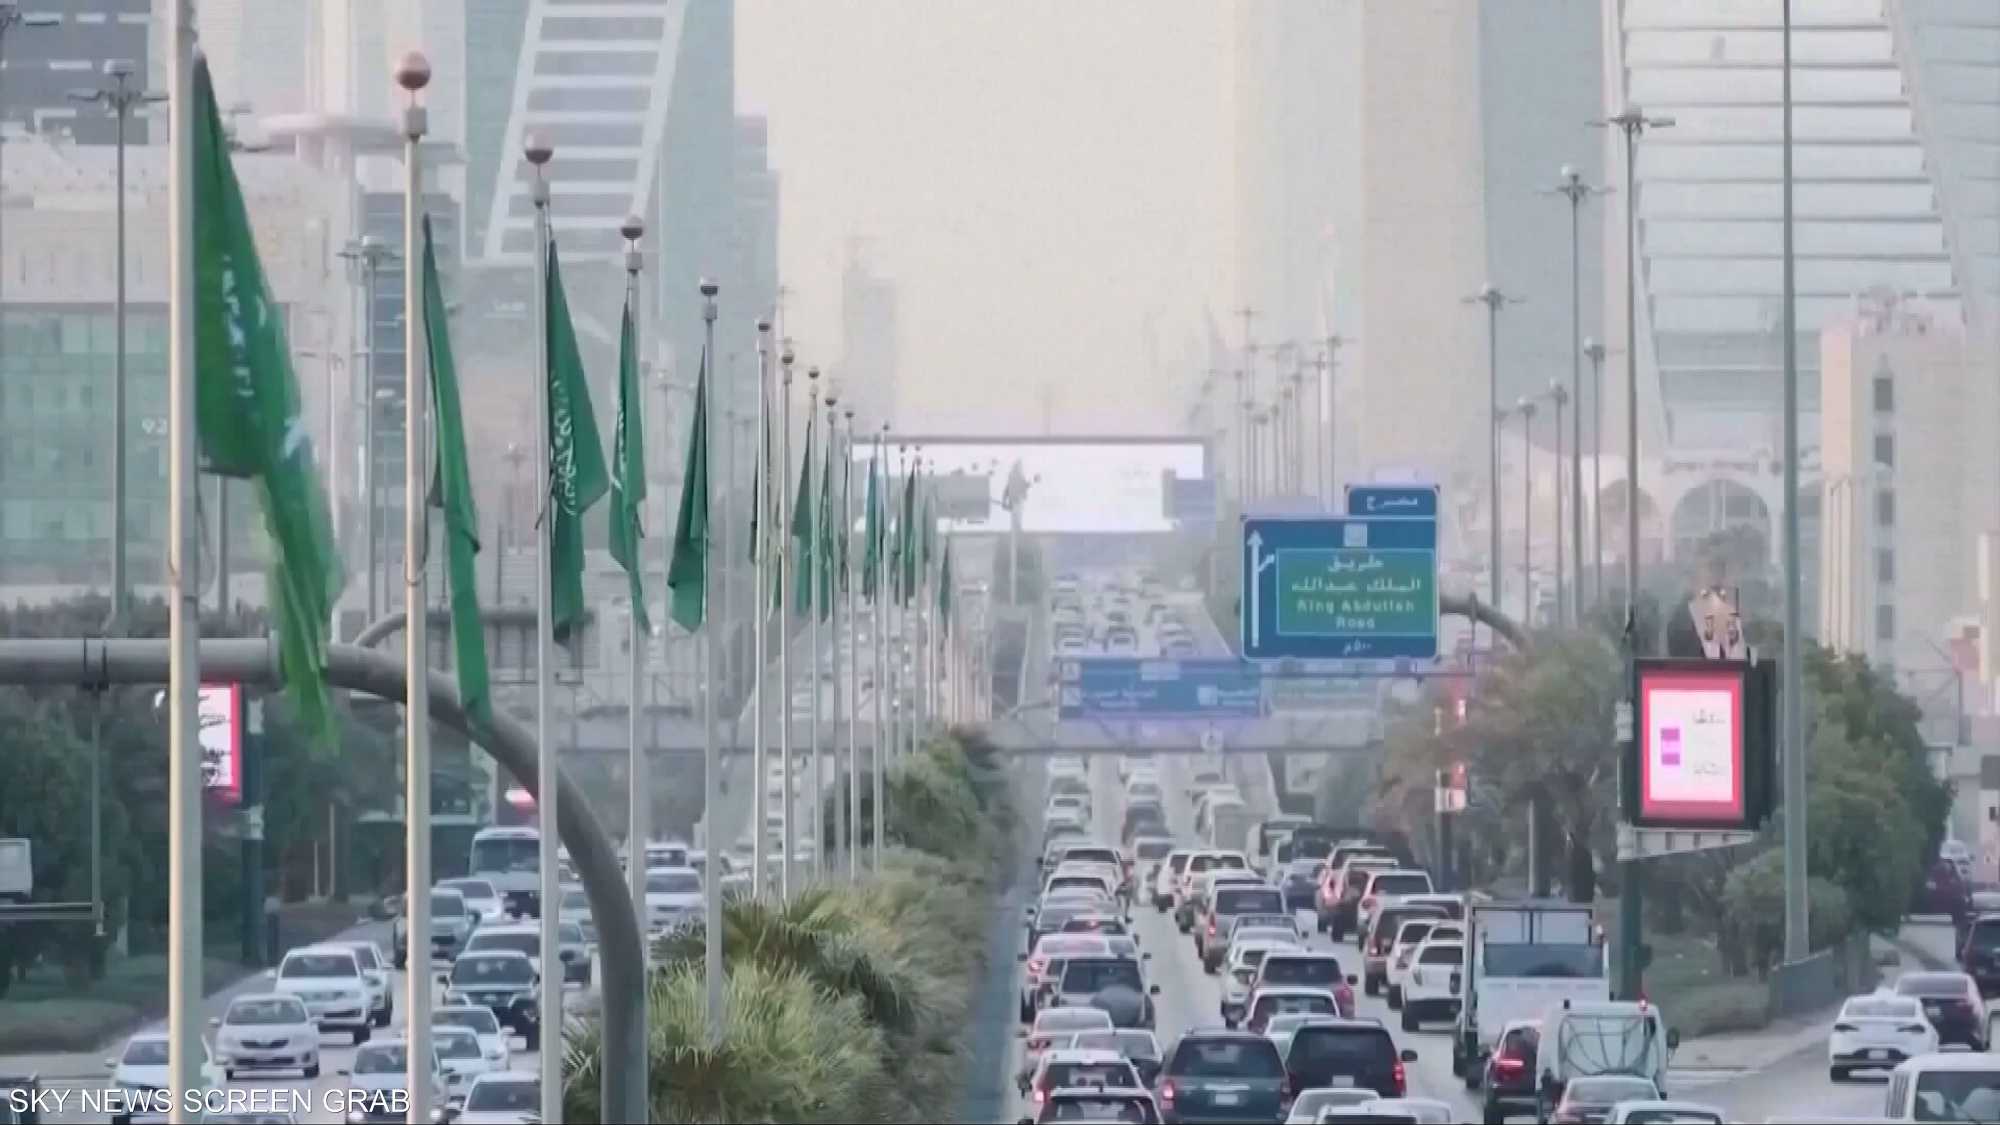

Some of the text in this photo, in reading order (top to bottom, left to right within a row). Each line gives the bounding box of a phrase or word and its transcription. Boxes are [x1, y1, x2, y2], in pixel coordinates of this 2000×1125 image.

[1328, 554, 1384, 572] طريق
[1366, 577, 1421, 592] الملك
[1297, 599, 1415, 615] King Abdullah
[1336, 615, 1375, 630] Road
